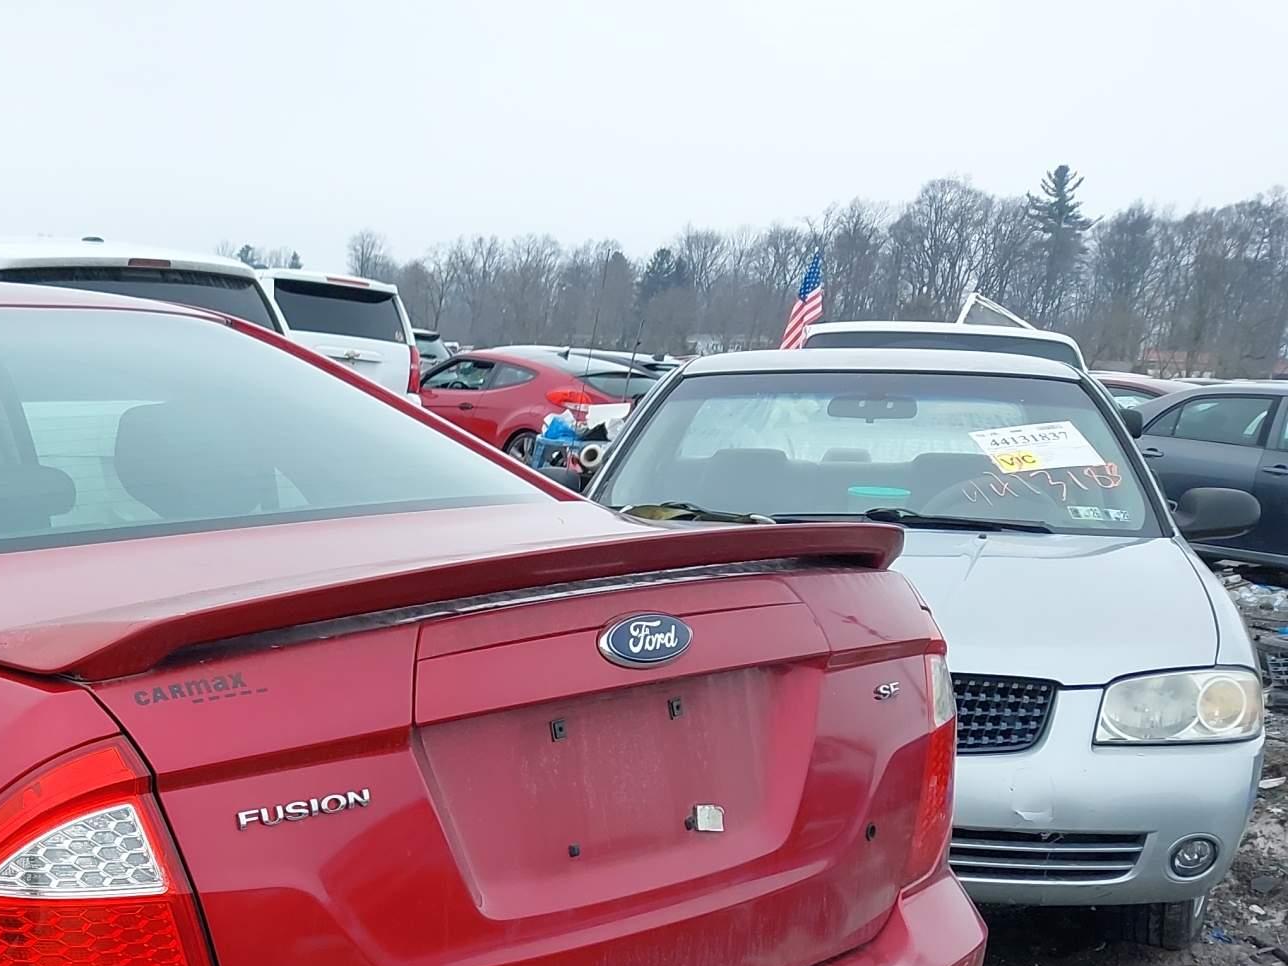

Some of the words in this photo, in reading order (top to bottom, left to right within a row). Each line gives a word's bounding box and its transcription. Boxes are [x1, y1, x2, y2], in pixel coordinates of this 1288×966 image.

[990, 431, 1069, 447] 44131837
[629, 619, 679, 654] Ford
[873, 681, 901, 701] SE
[235, 787, 372, 833] FUSION
